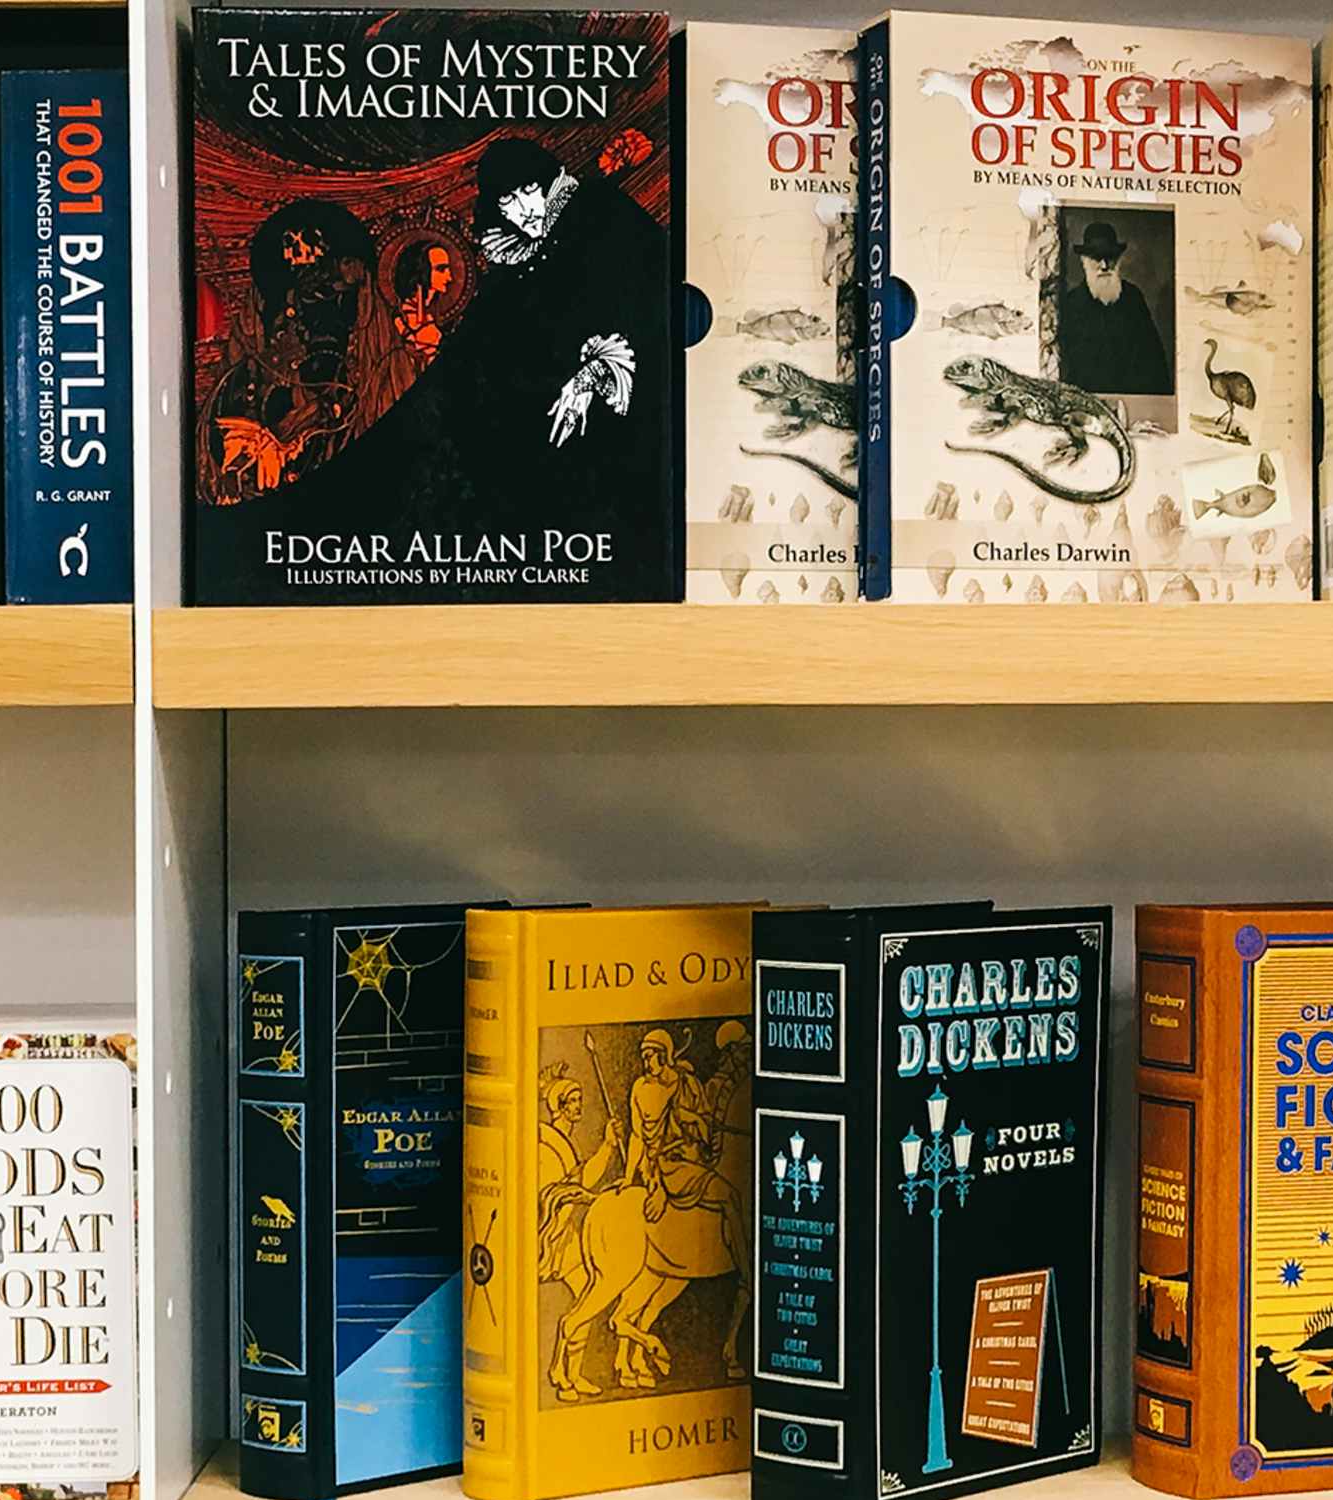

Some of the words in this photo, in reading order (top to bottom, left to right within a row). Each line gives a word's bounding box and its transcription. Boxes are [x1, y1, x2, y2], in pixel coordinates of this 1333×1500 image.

[218, 38, 346, 79] TALES
[366, 44, 420, 79] OF
[443, 41, 646, 79] MYSTERY
[248, 84, 280, 116] &
[298, 79, 608, 119] IMAGINATION
[969, 68, 1241, 131] ORIGIN
[57, 100, 104, 214] 1001
[971, 122, 1039, 167] OF
[1050, 127, 1242, 176] SPECIES
[973, 171, 994, 185] BY
[999, 172, 1054, 187] MEANS
[1058, 175, 1078, 188] OF
[1082, 176, 1154, 192] NATURAL
[1157, 179, 1242, 196] SELECTION
[59, 235, 106, 468] BATTLES
[265, 531, 389, 565] EDGAR
[406, 532, 526, 563] ALLAN
[543, 530, 612, 562] POE
[973, 542, 1053, 564] Charles
[1057, 543, 1131, 564] Darwin
[287, 567, 423, 584] ILLUSTRATIONS
[430, 569, 450, 584] BY
[455, 567, 517, 584] HARRY
[521, 567, 589, 584] CLARKE
[899, 955, 1082, 1018] CHARLES
[898, 1011, 1081, 1077] DICKENS
[998, 1123, 1063, 1146] FOUR
[983, 1145, 1075, 1174] NOVELS
[1275, 1139, 1309, 1173] &
[9, 1205, 114, 1254] EAT
[9, 1317, 109, 1366] DIE
[629, 1417, 739, 1454] HOMER
